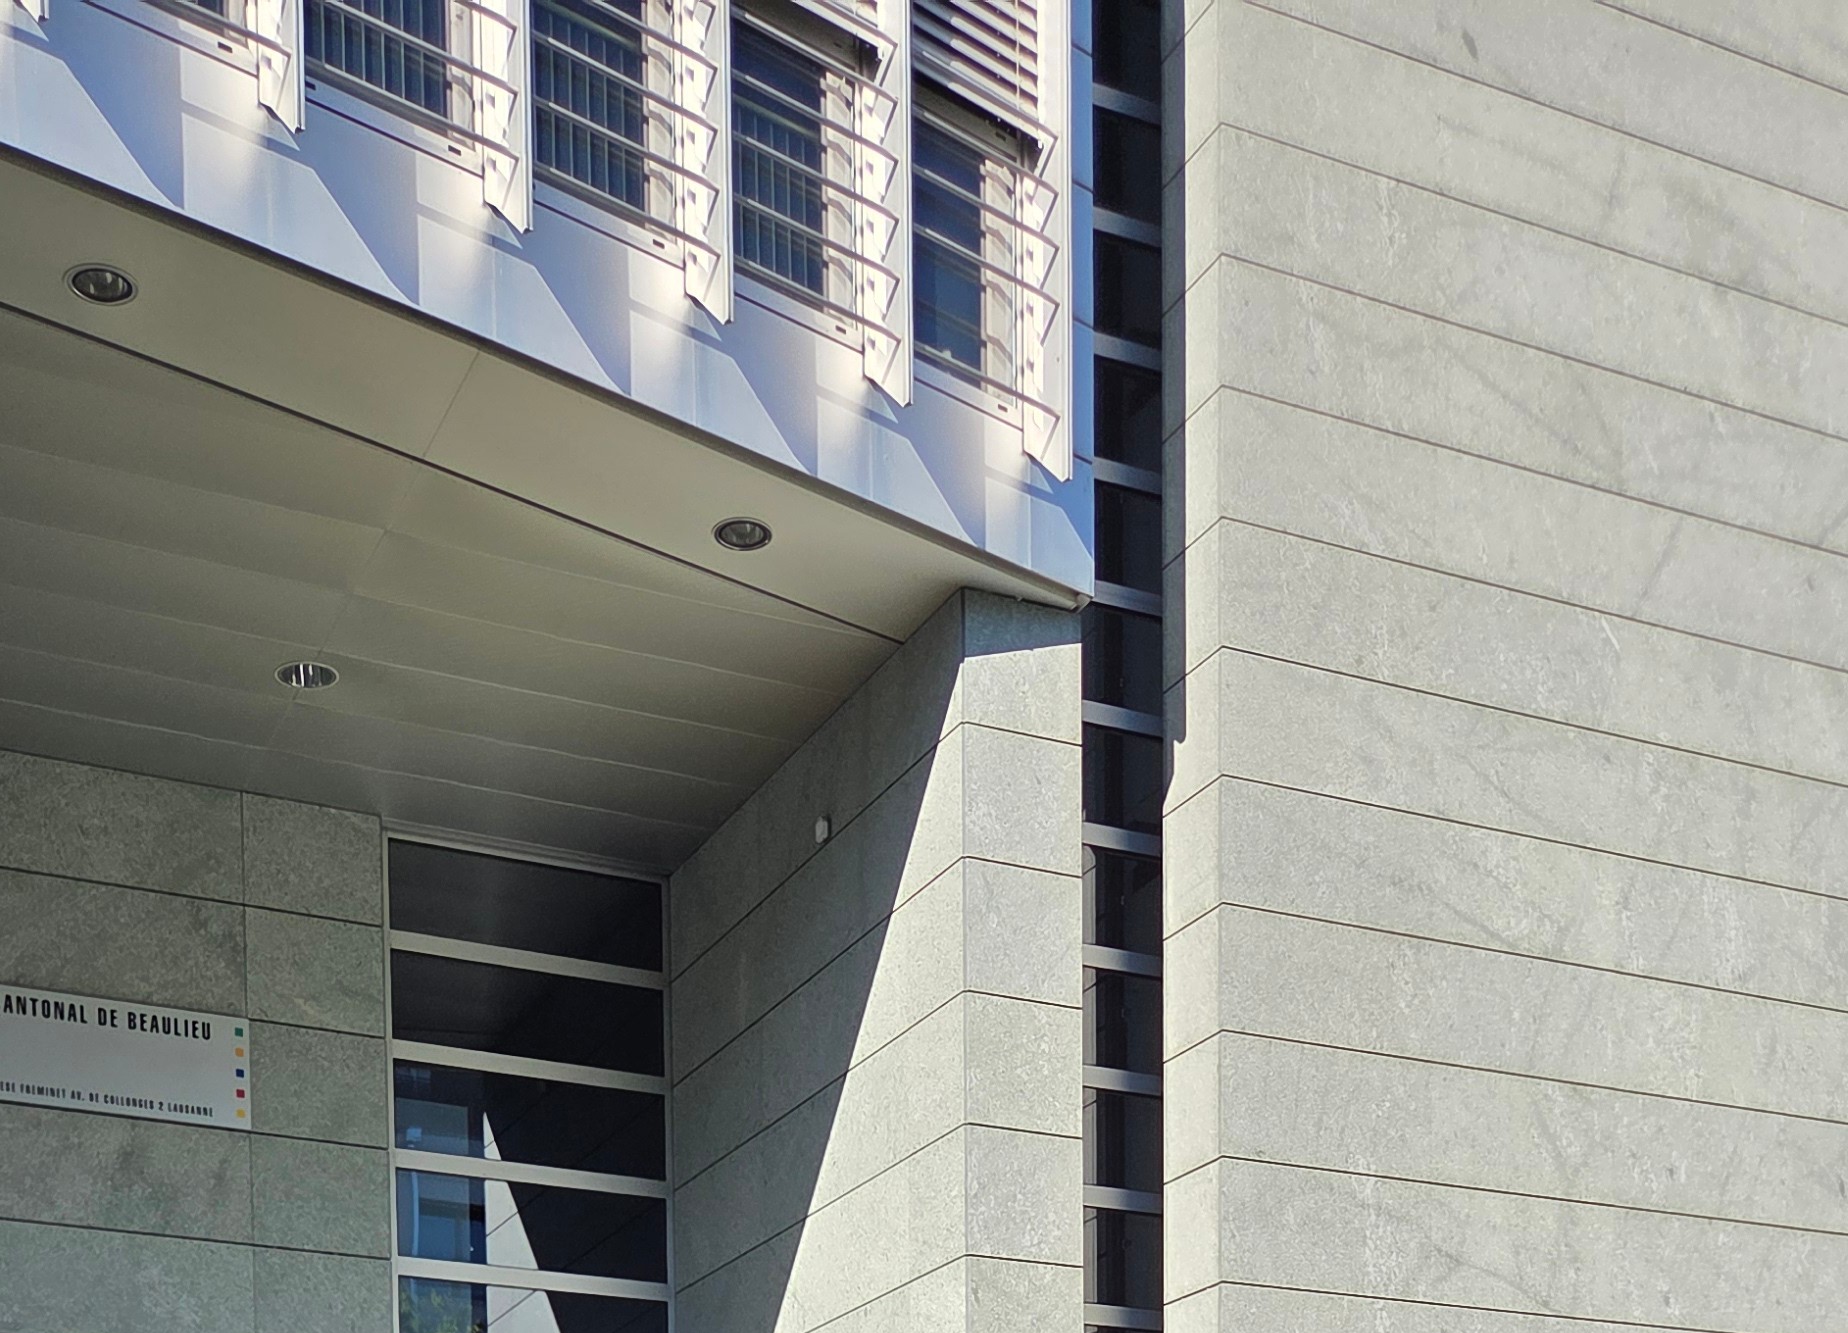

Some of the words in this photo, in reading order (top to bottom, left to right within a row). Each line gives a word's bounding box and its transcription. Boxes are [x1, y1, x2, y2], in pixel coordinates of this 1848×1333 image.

[3, 994, 88, 1024] ANTONAL
[97, 1007, 118, 1028] DE
[127, 1011, 211, 1041] BEAULIEU
[103, 1094, 154, 1110] COLLONGES
[168, 1102, 213, 1118] LAUSANNE
